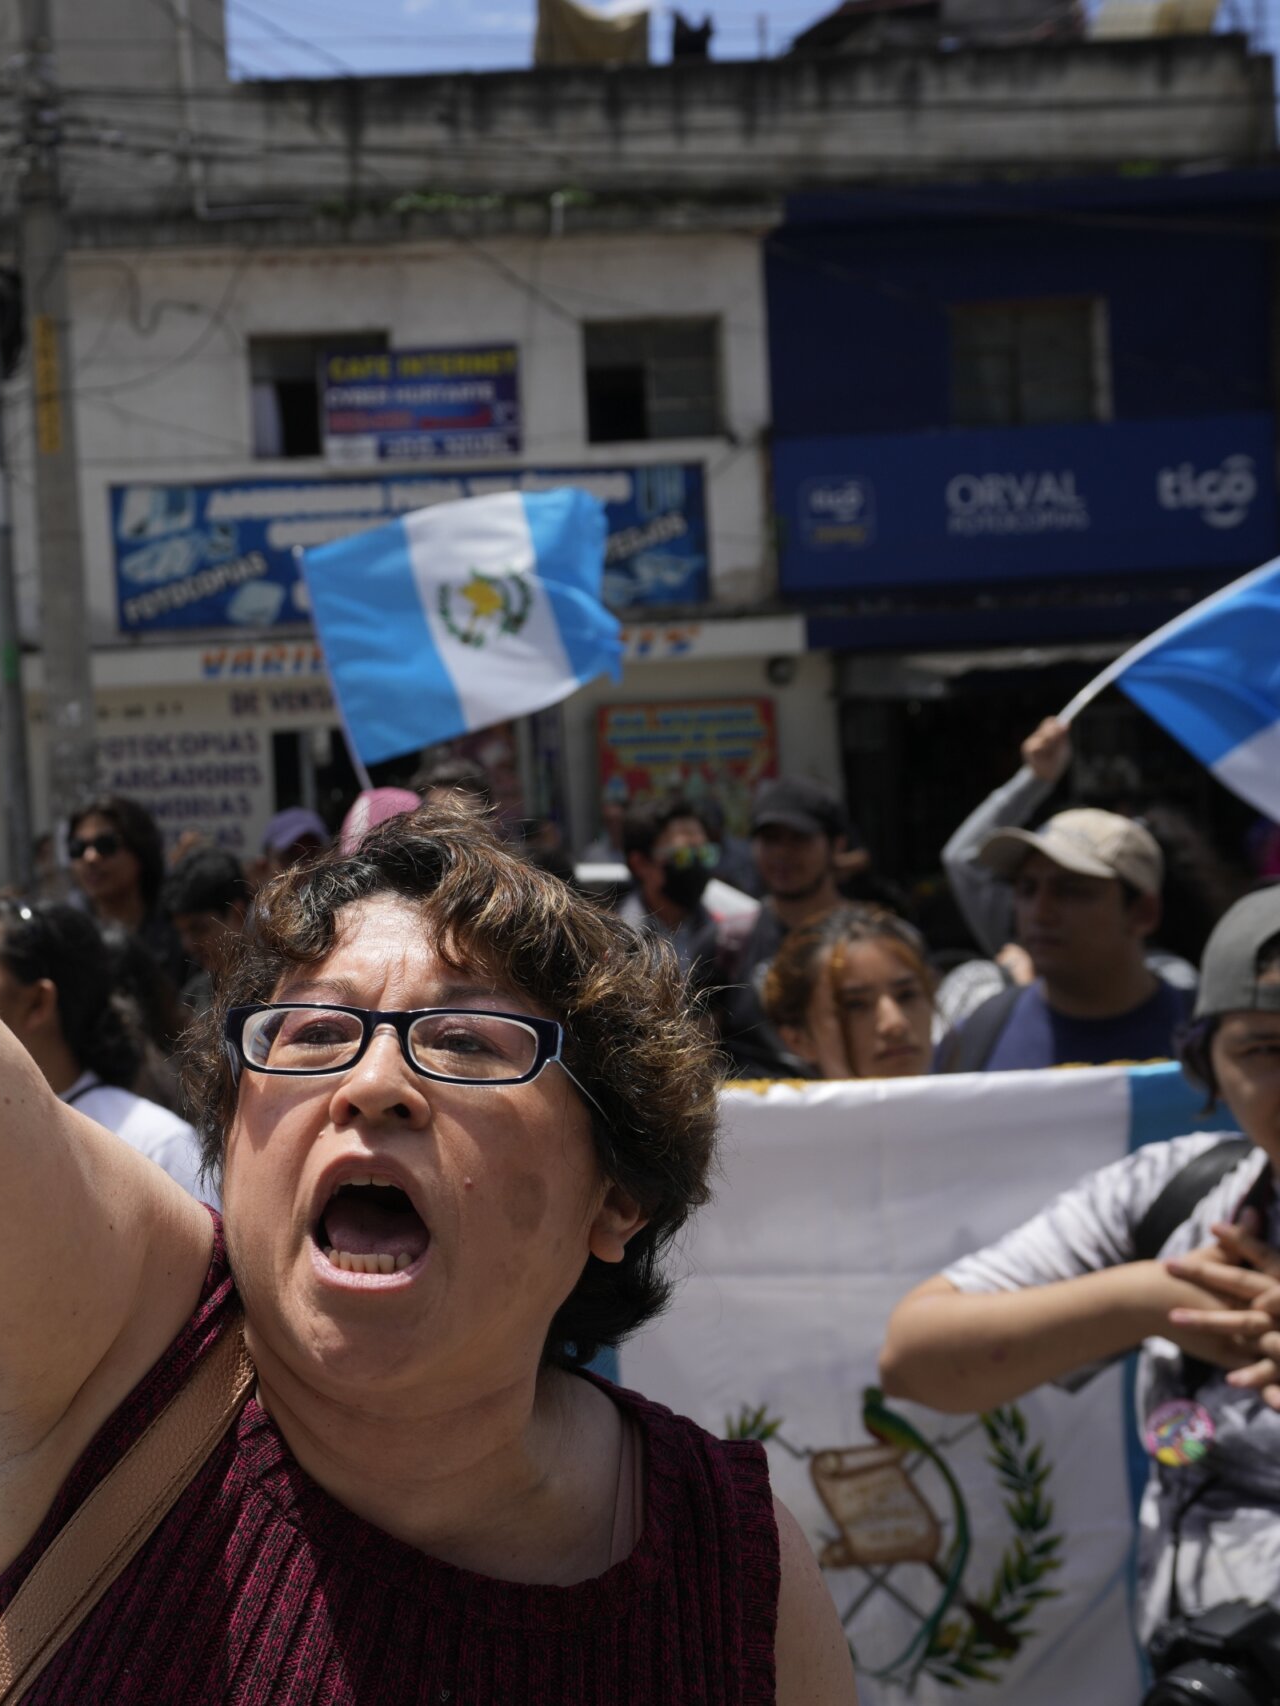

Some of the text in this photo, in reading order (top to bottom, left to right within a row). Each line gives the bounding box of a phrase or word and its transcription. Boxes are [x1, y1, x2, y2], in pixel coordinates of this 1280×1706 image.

[397, 350, 517, 377] INTERNET
[946, 470, 1084, 515] ORVAL
[124, 552, 268, 624] FOTOCOPIAS
[231, 689, 260, 716] DE
